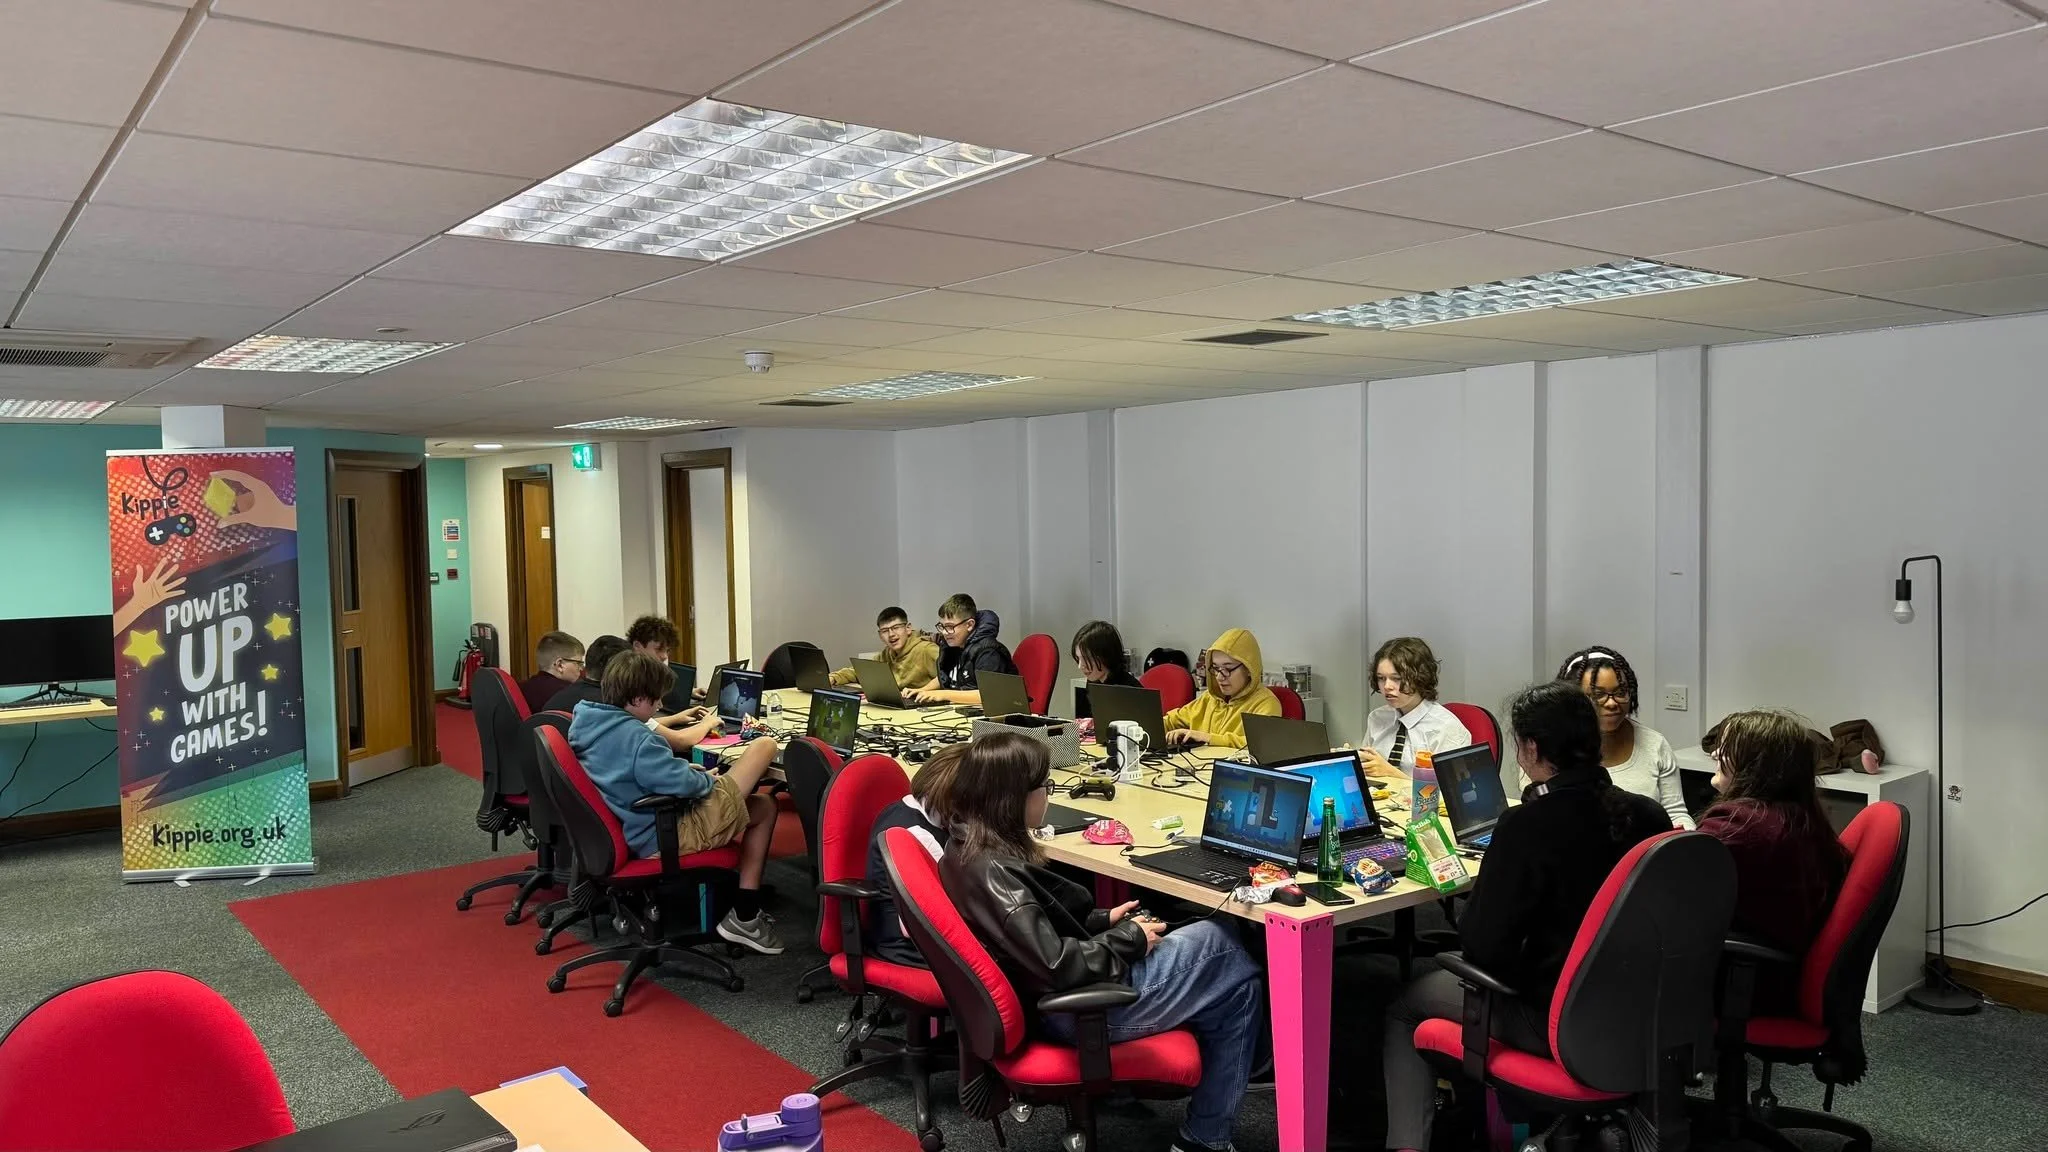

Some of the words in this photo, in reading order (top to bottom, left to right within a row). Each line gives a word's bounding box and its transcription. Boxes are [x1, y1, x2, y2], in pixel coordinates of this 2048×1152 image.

[122, 492, 179, 520] Kippie
[165, 582, 249, 635] POWER
[179, 615, 253, 693] UP
[170, 689, 268, 764] GAMES!
[182, 681, 247, 726] WITH
[153, 816, 287, 852] Kippie.org.uk
